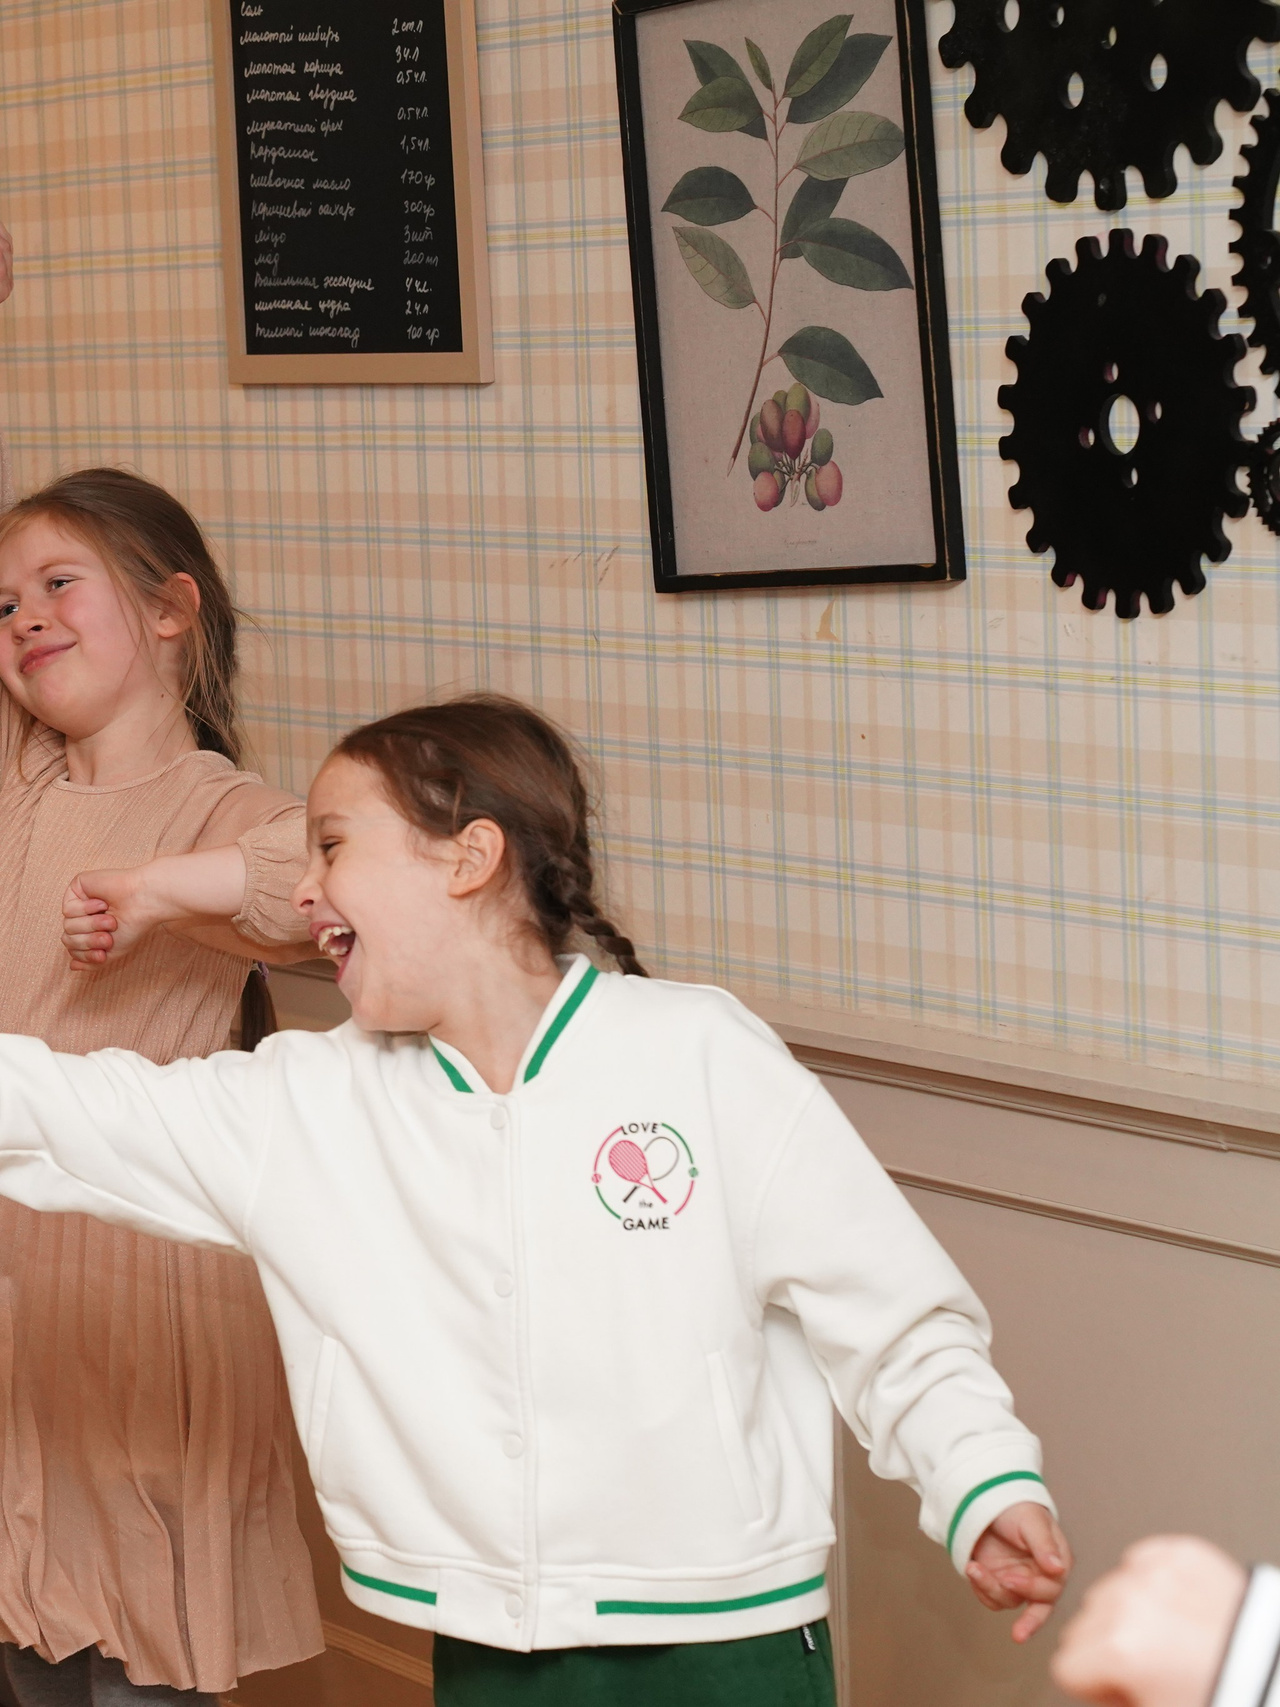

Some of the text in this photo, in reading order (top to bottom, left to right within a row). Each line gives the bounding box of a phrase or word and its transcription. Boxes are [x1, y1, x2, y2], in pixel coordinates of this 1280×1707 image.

[392, 18, 400, 36] 2
[405, 300, 412, 315] 2
[620, 1121, 659, 1136] LOVE
[639, 1199, 654, 1209] the
[622, 1216, 670, 1231] GAME
